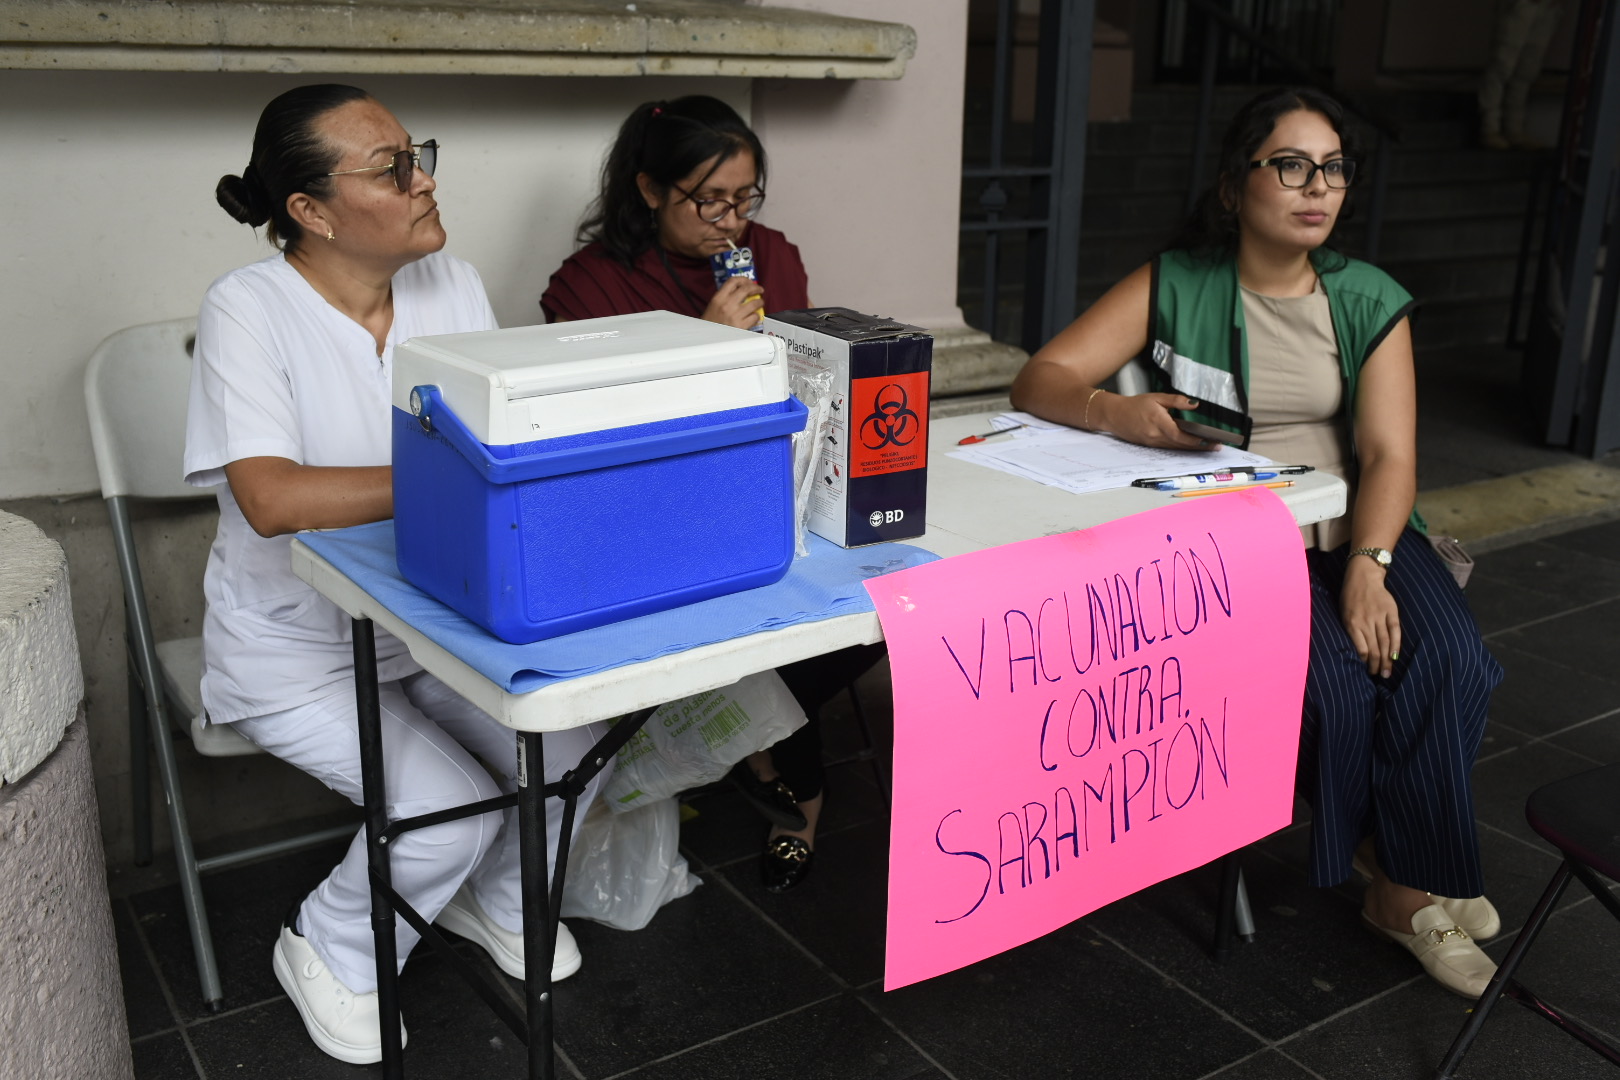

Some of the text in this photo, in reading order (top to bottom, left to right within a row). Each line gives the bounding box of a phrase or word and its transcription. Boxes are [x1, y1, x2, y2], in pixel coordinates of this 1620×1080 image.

[885, 509, 904, 524] BD
[941, 532, 1232, 701] VACUNACIÓN
[663, 713, 680, 728] de
[671, 714, 702, 738] cuesta
[702, 693, 726, 717] menos
[934, 696, 1230, 924] SARAMPIÓN
